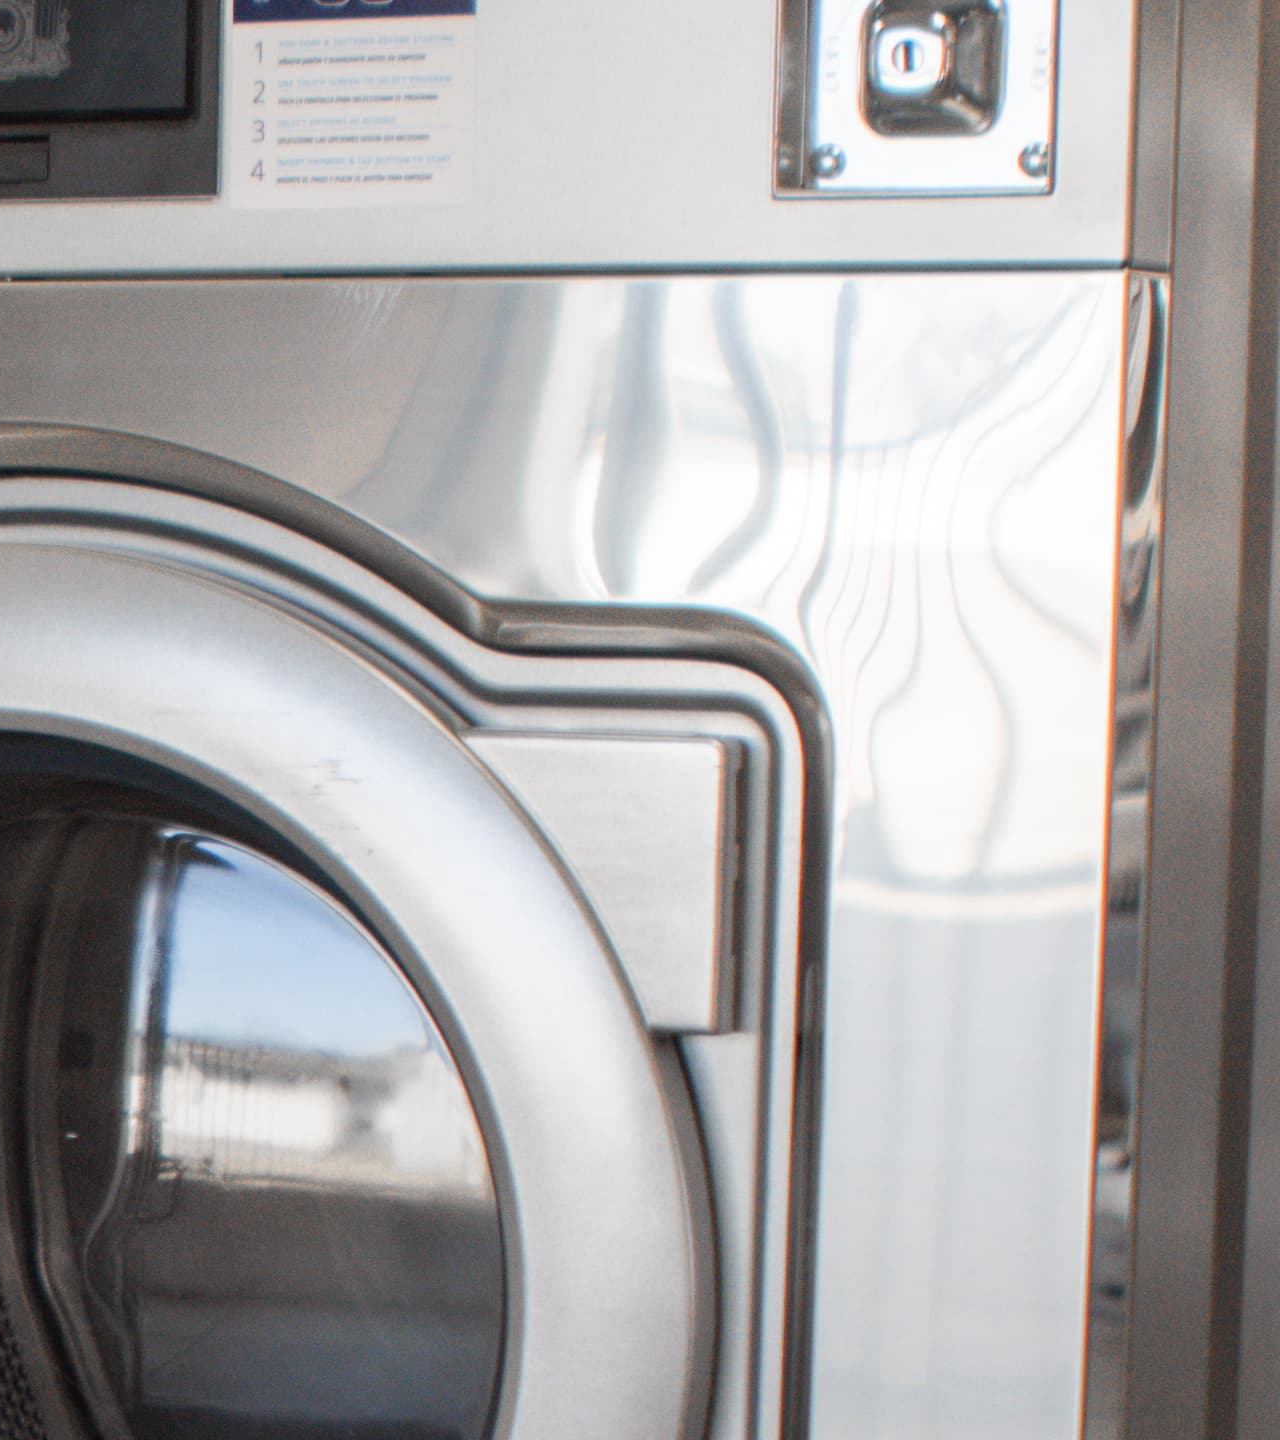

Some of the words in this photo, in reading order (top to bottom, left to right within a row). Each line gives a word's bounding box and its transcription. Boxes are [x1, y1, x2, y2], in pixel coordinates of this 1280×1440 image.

[254, 40, 265, 65] 1
[252, 79, 266, 104] 2
[251, 119, 266, 143] 3
[250, 159, 266, 182] 4
